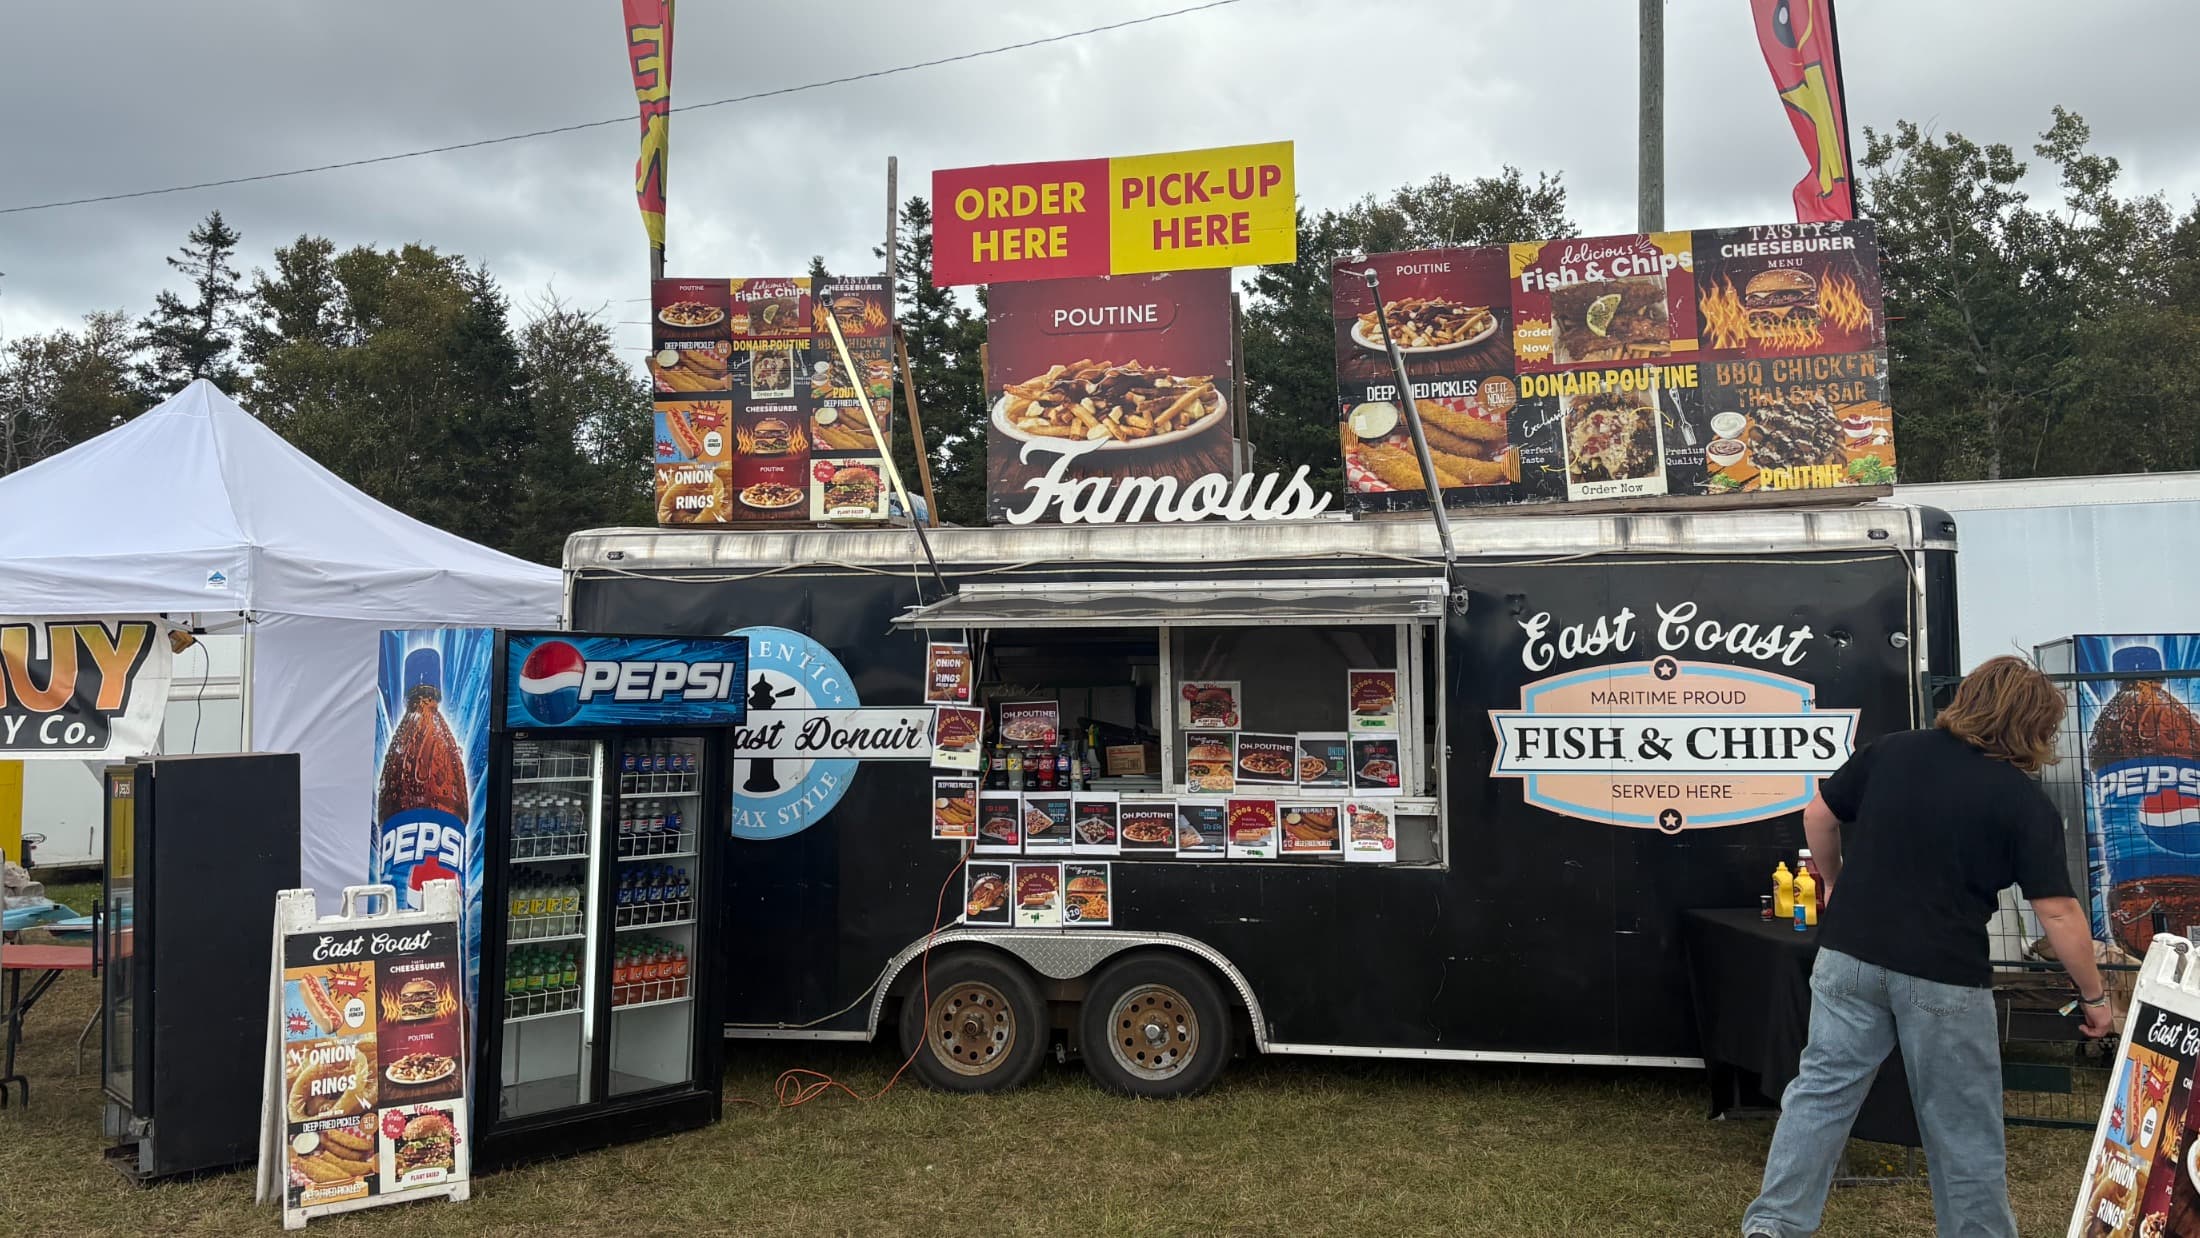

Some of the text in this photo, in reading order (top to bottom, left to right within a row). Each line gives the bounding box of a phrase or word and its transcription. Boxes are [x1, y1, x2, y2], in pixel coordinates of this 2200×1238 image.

[1121, 164, 1282, 210] PICK-UP
[955, 181, 1086, 221] ORDER
[1152, 212, 1250, 251] HERE
[1749, 223, 1825, 241] TASTY
[972, 225, 1068, 263] HERE
[1561, 242, 1634, 265] delicious
[1720, 237, 1855, 258] CHEESEBURER
[1396, 262, 1451, 277] POUTINE
[1520, 249, 1692, 293] Fish & Chips
[1768, 258, 1803, 268] MENU
[735, 285, 812, 302] Fish & Chips
[1054, 303, 1158, 328] POUTINE
[1518, 327, 1553, 338] Order
[664, 342, 678, 350] DEEP
[694, 341, 715, 349] PICKLES
[1522, 344, 1550, 353] Now
[1772, 352, 1876, 383] CHICKEN
[1366, 380, 1478, 402] DEEP IED PICKLES
[1485, 382, 1508, 393] GET IT
[1520, 364, 1698, 399] DONAIR POUTINE
[824, 399, 853, 407] DEEP FRIED
[1487, 392, 1506, 404] NOW
[745, 405, 798, 413] CHEESEBURER
[1522, 407, 1575, 438] Exclusive
[1520, 446, 1553, 457] perfect
[1665, 447, 1705, 455] Premium
[1665, 456, 1704, 466] Quality
[674, 470, 714, 485] ONION
[1006, 437, 1332, 524] Famous
[1581, 483, 1644, 495] Order Now
[676, 494, 715, 510] RINGS
[1518, 600, 1816, 672] East Coast
[0, 623, 148, 713] UY
[748, 641, 840, 696] ENTIC
[936, 659, 961, 667] ONION
[577, 660, 737, 704] PEPSI
[936, 674, 960, 683] RINGS
[1590, 690, 1746, 706] MARITIME PROUD
[39, 714, 96, 745] Co.
[794, 715, 923, 751] Donair
[1514, 725, 1837, 762] FISH & CHIPS
[778, 770, 838, 826] STYLE
[1611, 783, 1732, 799] SERVED HERE
[1229, 806, 1252, 826] HOTDOG
[381, 821, 465, 874] PEPSI
[313, 930, 432, 961] East Coast
[389, 961, 446, 974] CHEESEBURER
[408, 1033, 434, 1041] POUTINE
[2147, 1010, 2183, 1048] East
[309, 1044, 356, 1066] ONION
[311, 1074, 357, 1097] RINGS
[303, 1116, 360, 1132] DEEP FRIED PICKLES
[2108, 1157, 2137, 1191] ONION
[303, 1189, 319, 1201] DEEP
[2096, 1197, 2125, 1231] RINGS
